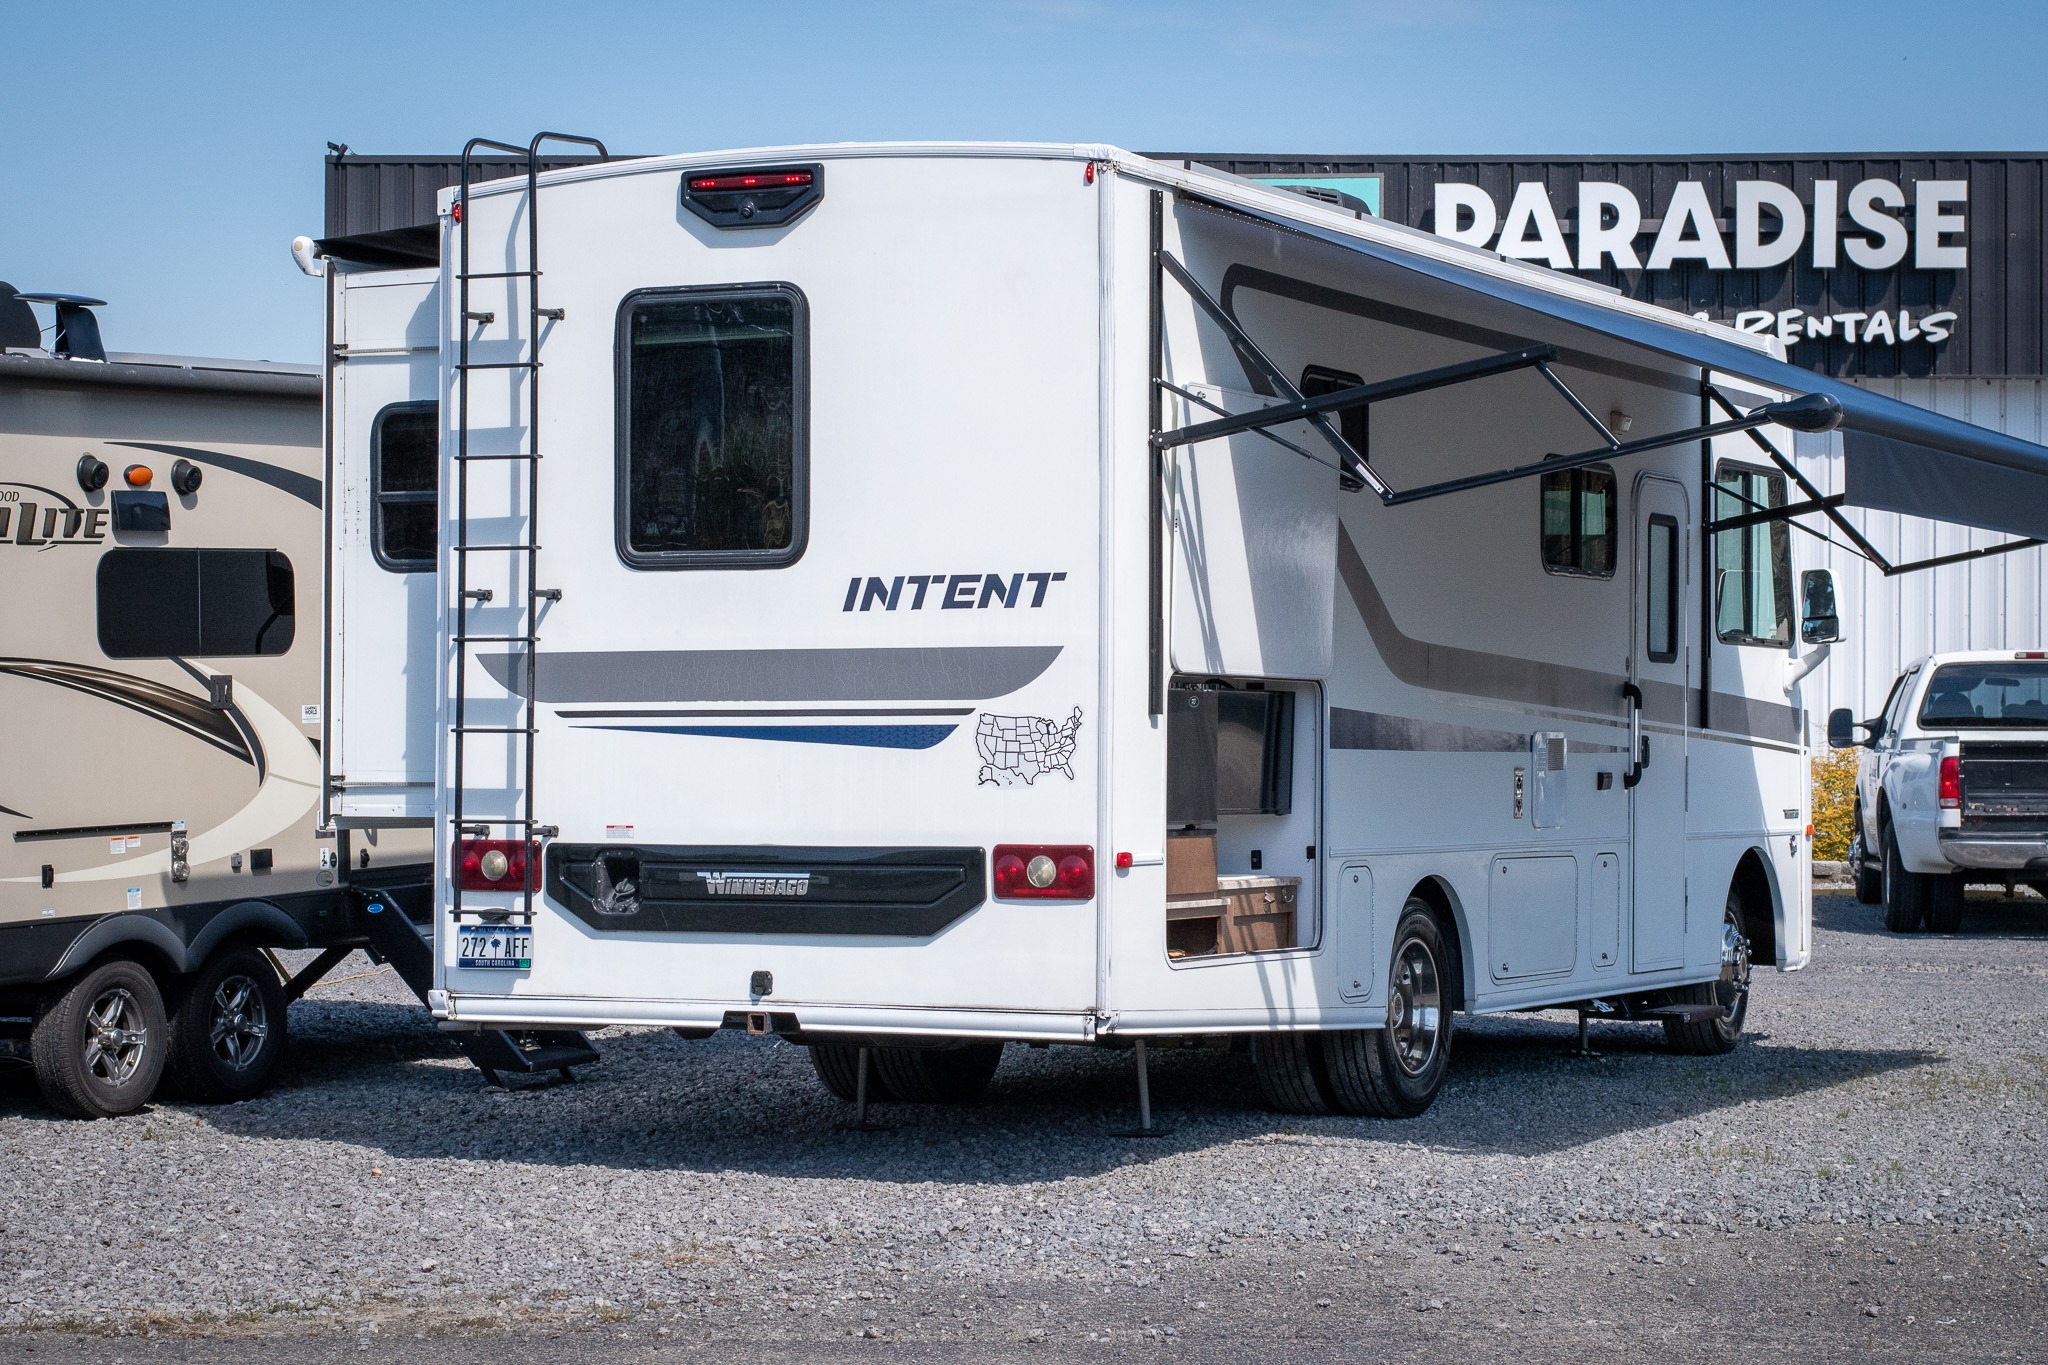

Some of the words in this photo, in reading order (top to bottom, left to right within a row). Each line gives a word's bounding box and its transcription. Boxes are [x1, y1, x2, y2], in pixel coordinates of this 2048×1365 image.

[1435, 178, 1968, 270] PARADISE
[1735, 309, 1958, 346] RENTALS
[842, 571, 1068, 612] INTENT
[697, 871, 810, 896] WINNEBAGO
[462, 937, 487, 958] 272
[504, 937, 529, 958] AFF
